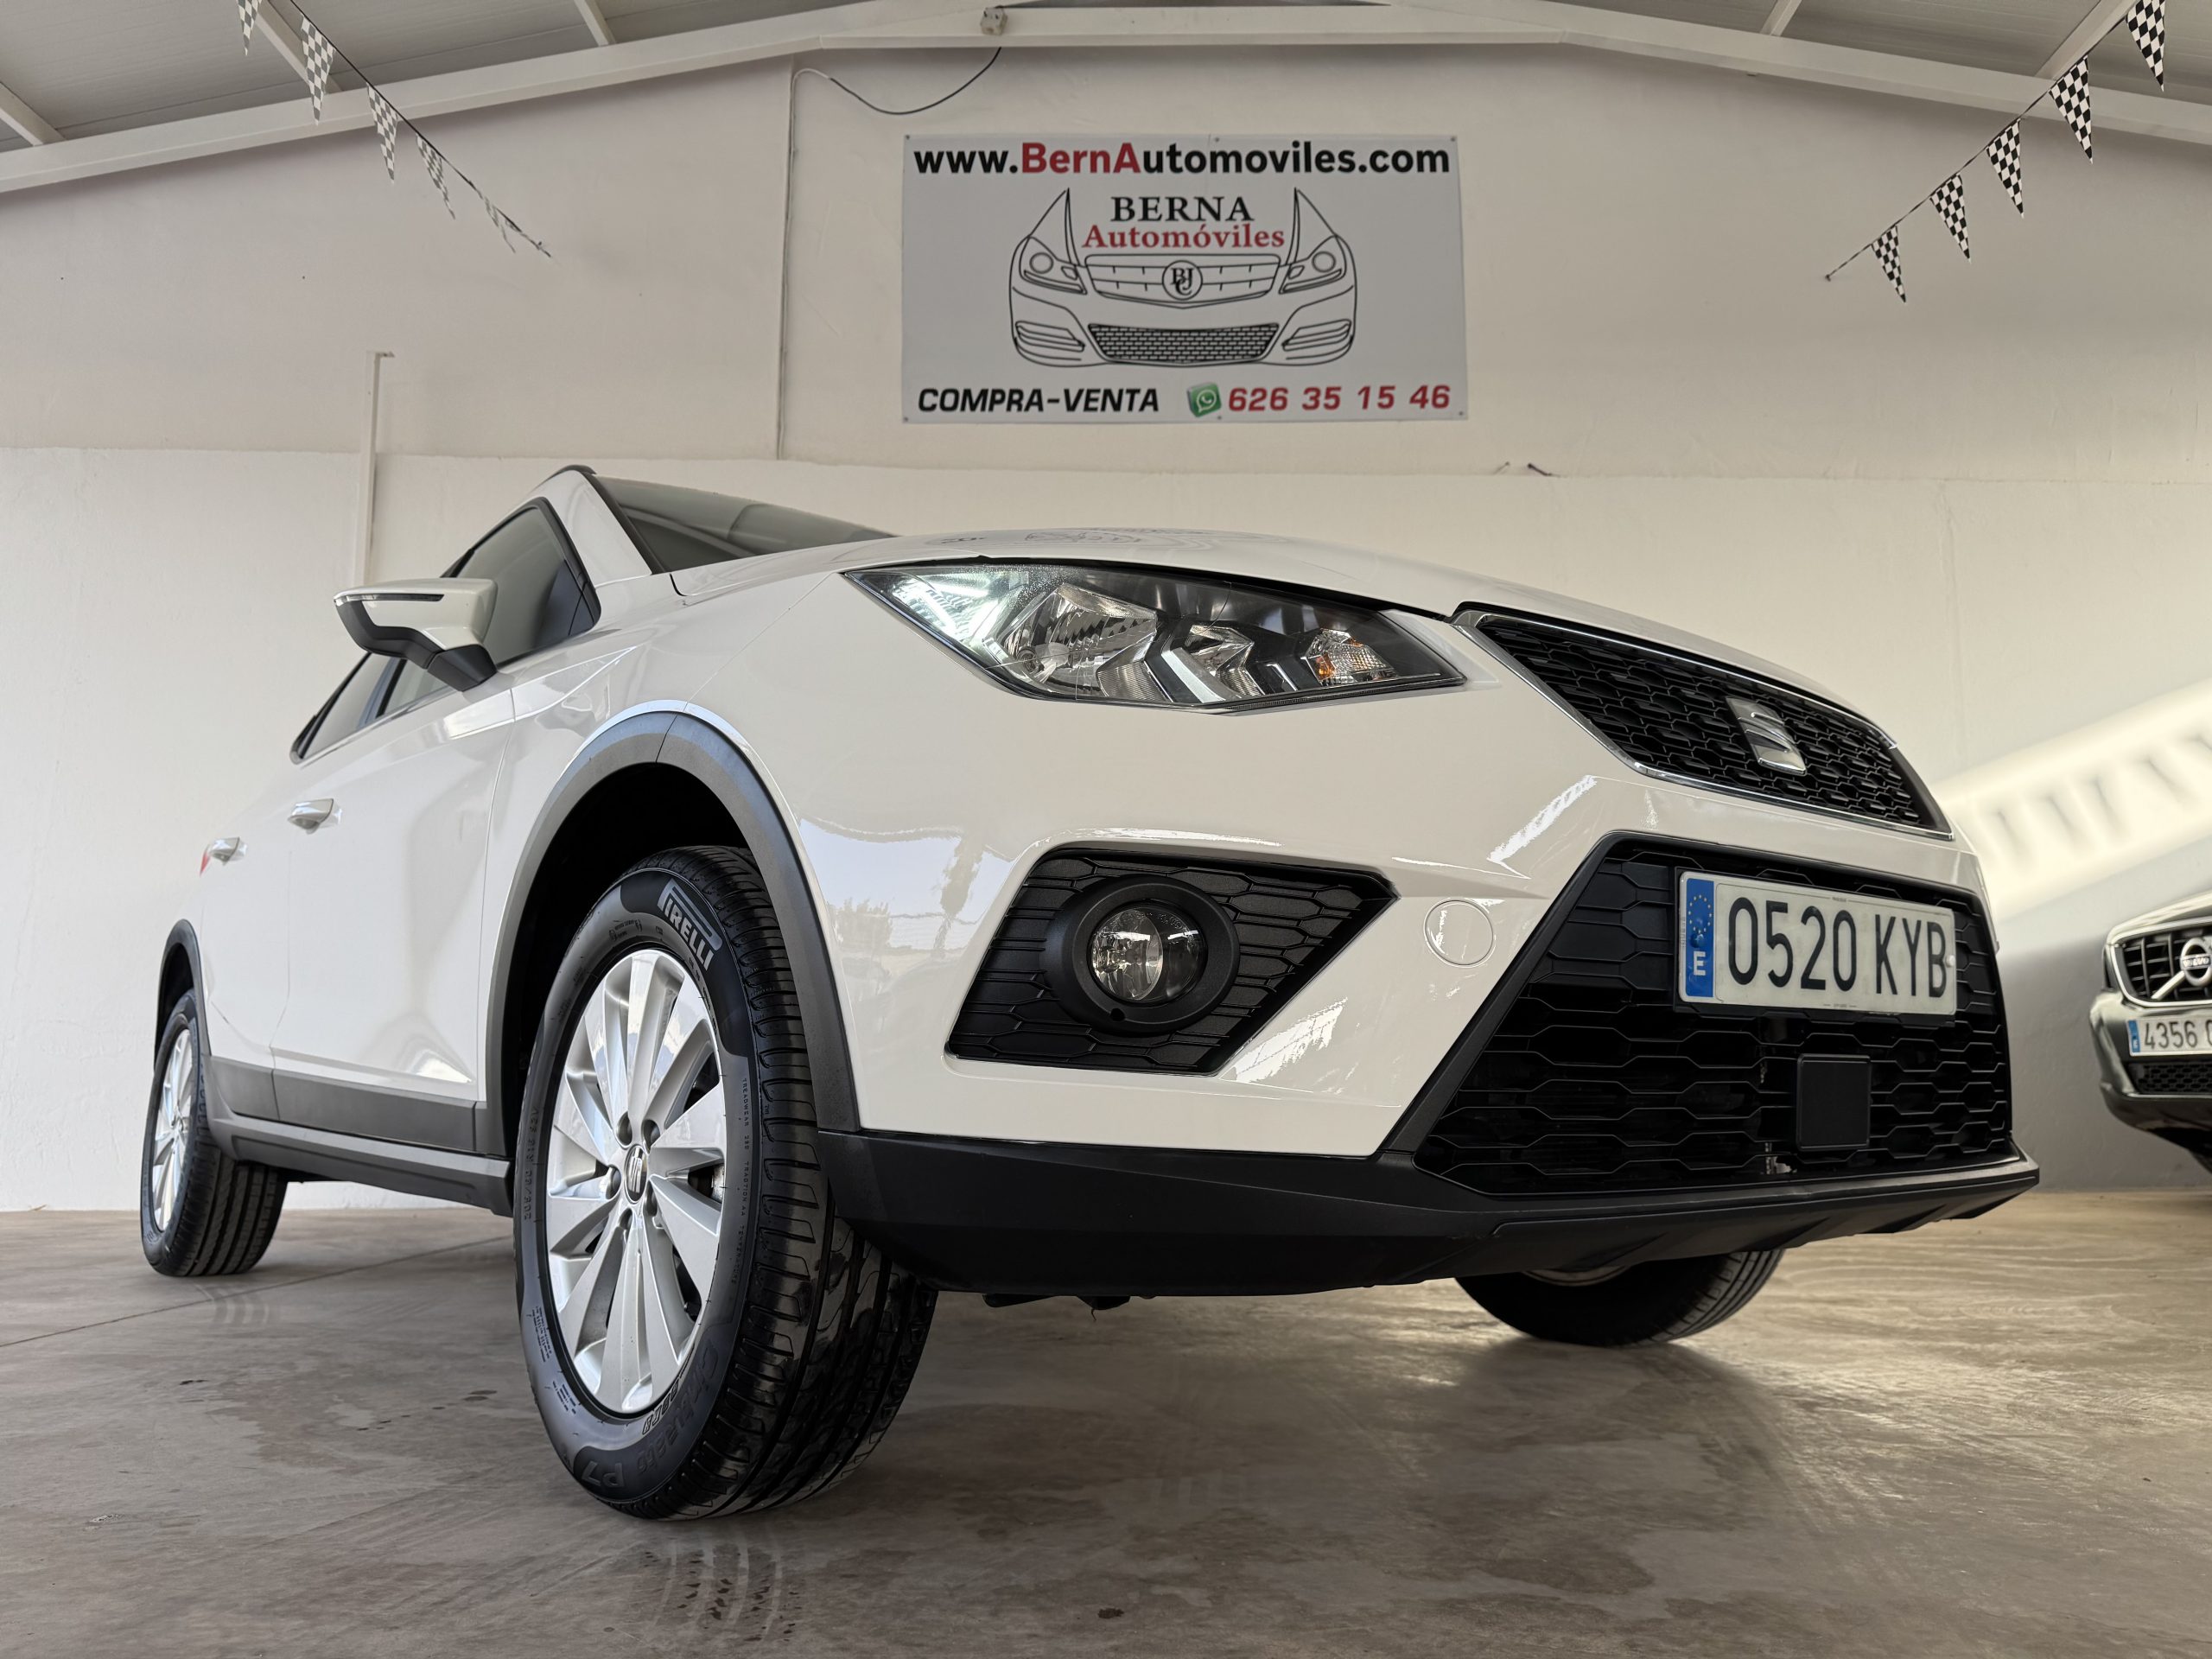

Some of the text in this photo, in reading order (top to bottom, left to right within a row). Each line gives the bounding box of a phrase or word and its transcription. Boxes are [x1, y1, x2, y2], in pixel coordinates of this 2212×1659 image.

[913, 141, 1450, 174] www.BernAutomoviles.com
[1111, 196, 1255, 222] BERNA
[1082, 223, 1285, 248] Automóviles
[918, 388, 1160, 412] COMPRA-VENTA
[1228, 385, 1451, 411] 626 35 15 46
[657, 878, 723, 971] PIRELLI
[1728, 897, 1948, 998] 0520 KYB
[1694, 951, 1706, 976] E
[2145, 1020, 2198, 1049] 4356
